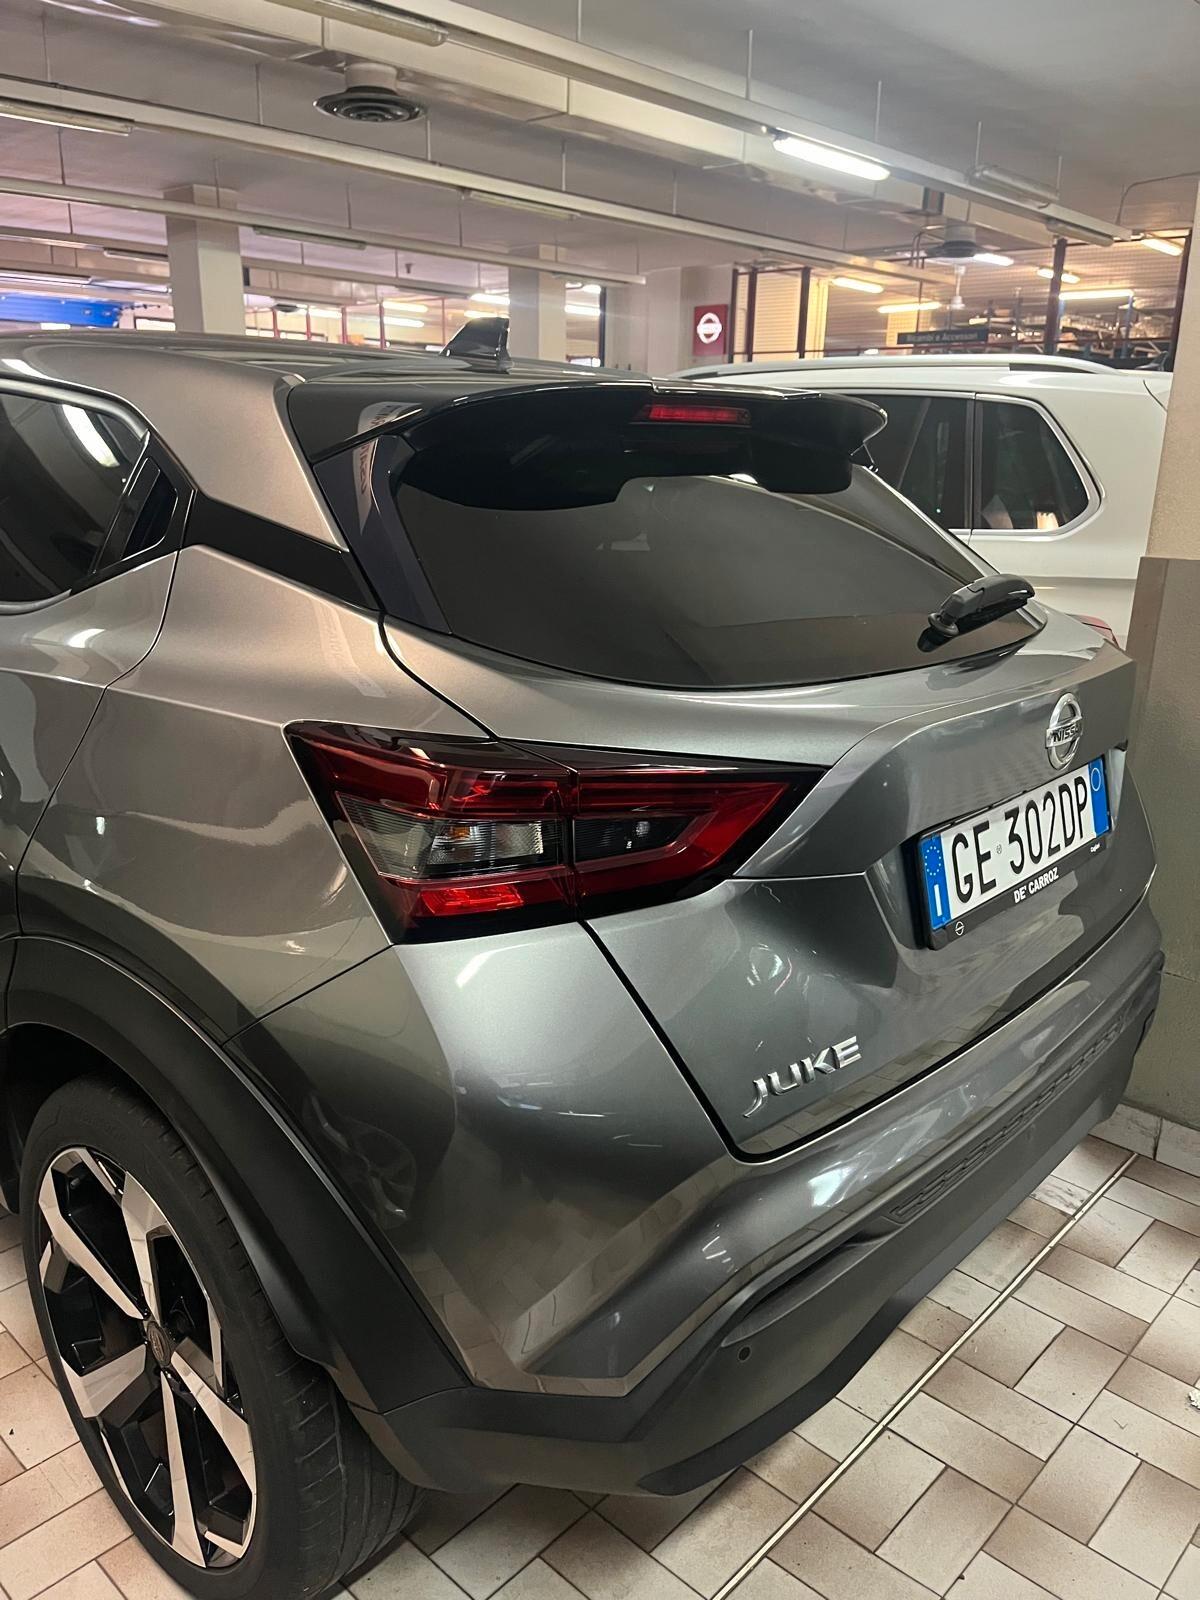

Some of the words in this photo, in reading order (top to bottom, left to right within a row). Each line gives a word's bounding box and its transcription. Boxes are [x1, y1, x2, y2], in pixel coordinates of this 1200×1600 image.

[951, 820, 997, 904] GE
[1004, 776, 1088, 875] 302DP
[934, 884, 943, 917] I
[1013, 884, 1027, 903] DE'
[1028, 866, 1059, 897] CARROZ
[743, 1035, 862, 1118] JUKE
